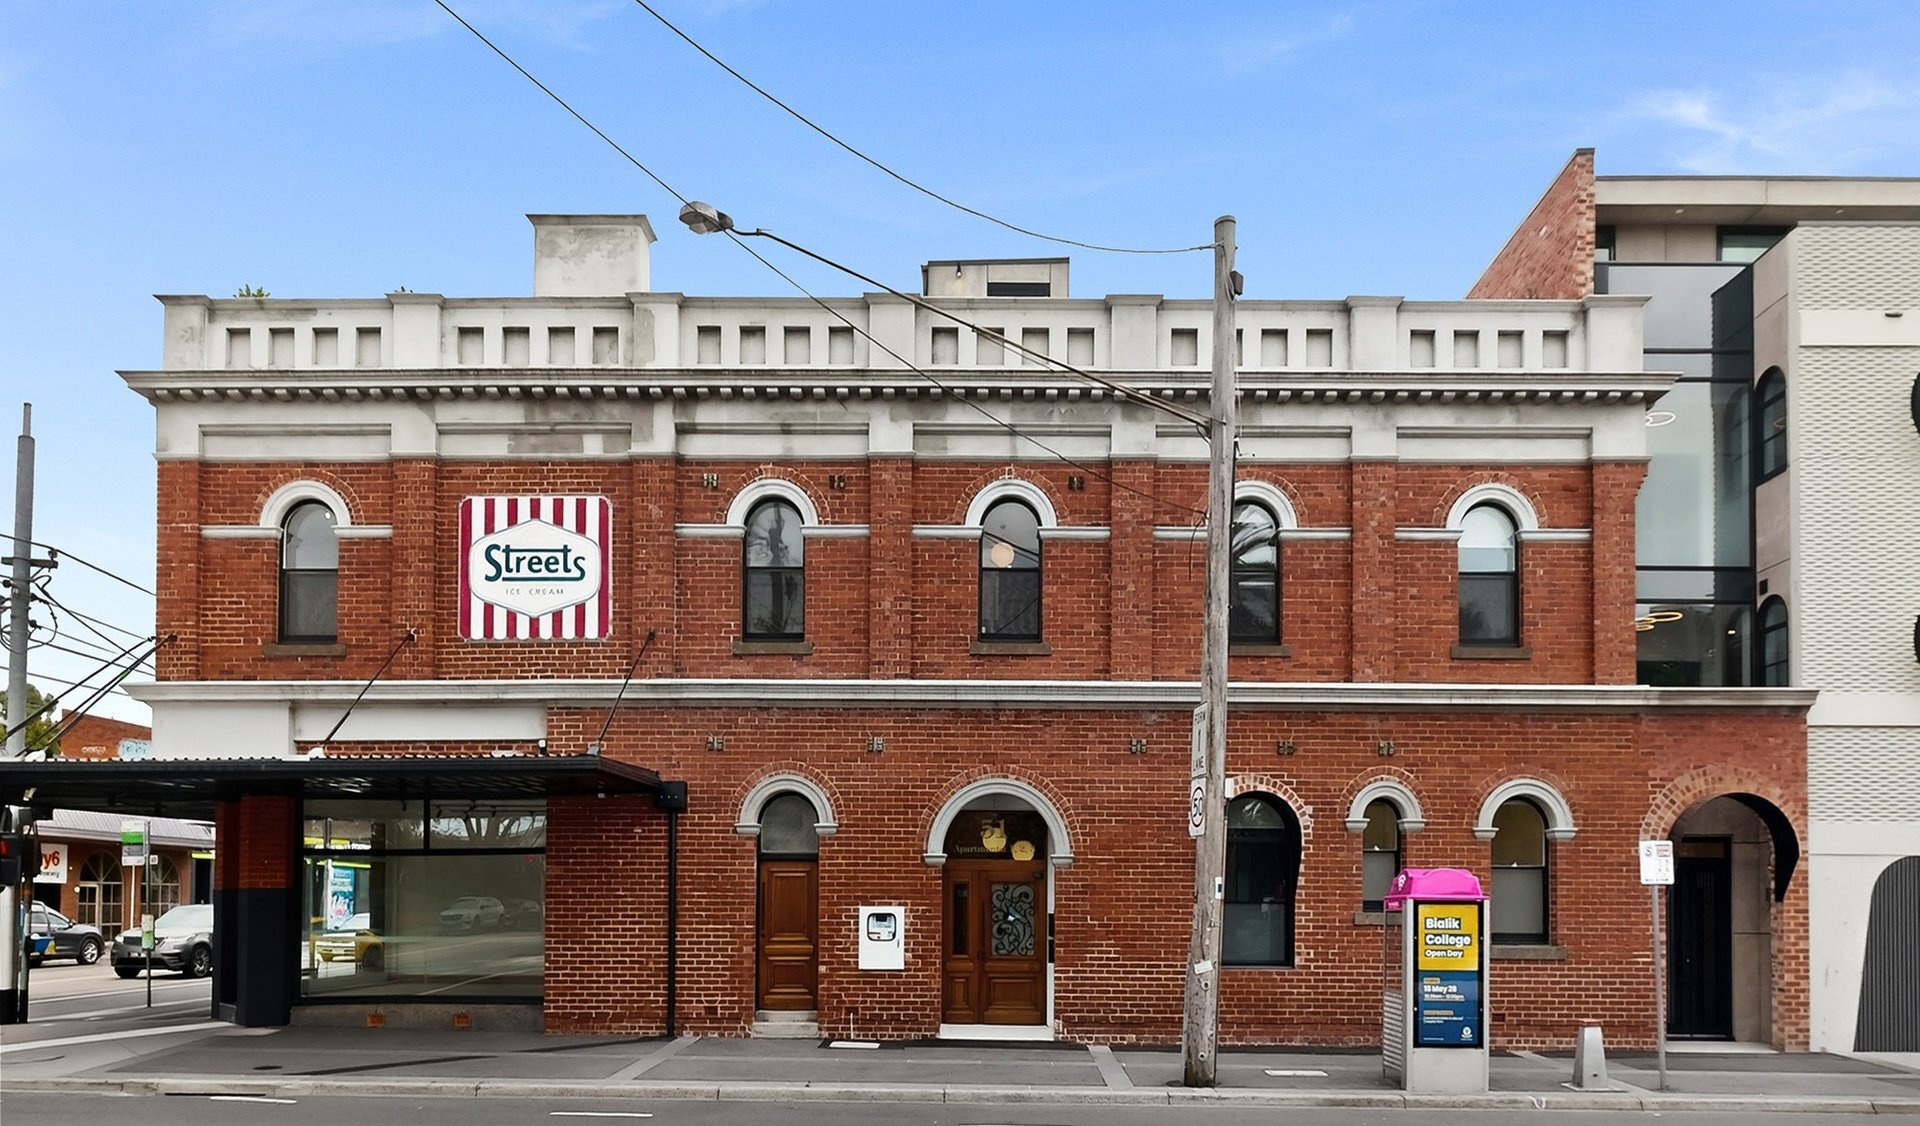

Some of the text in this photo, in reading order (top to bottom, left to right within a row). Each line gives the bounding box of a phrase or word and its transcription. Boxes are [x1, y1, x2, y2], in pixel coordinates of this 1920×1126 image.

[485, 543, 586, 582] Streets
[529, 588, 564, 596] CREAM
[1194, 711, 1206, 726] FORM
[1193, 755, 1205, 772] LANE
[1193, 797, 1204, 818] 50
[980, 819, 1007, 839] 51
[41, 851, 60, 870] y6
[1425, 917, 1460, 929] Bialik
[1425, 934, 1471, 947] College
[1425, 950, 1463, 958] Open Day
[1432, 985, 1448, 994] May
